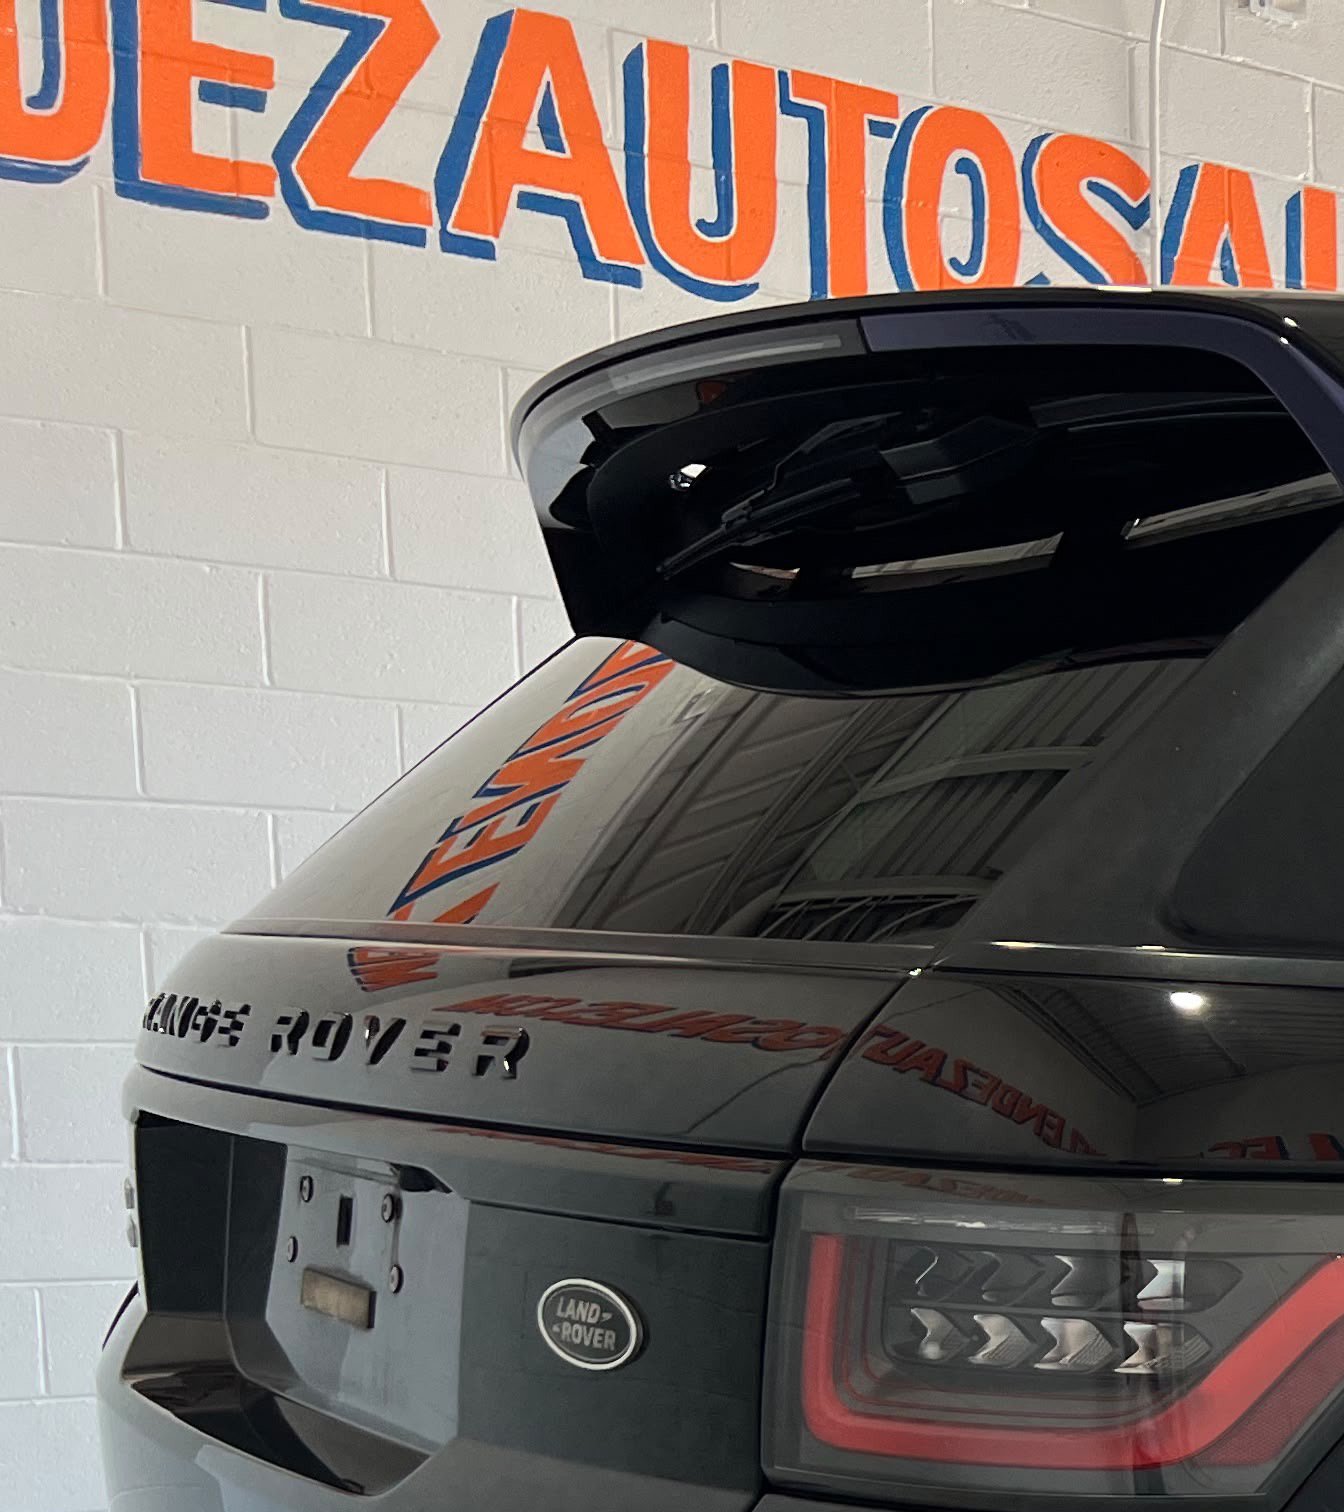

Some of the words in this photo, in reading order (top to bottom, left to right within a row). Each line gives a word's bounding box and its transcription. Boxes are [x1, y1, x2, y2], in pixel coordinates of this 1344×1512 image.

[143, 992, 252, 1047] RANGE
[269, 1007, 530, 1080] ROVER
[556, 1296, 602, 1323] LAND
